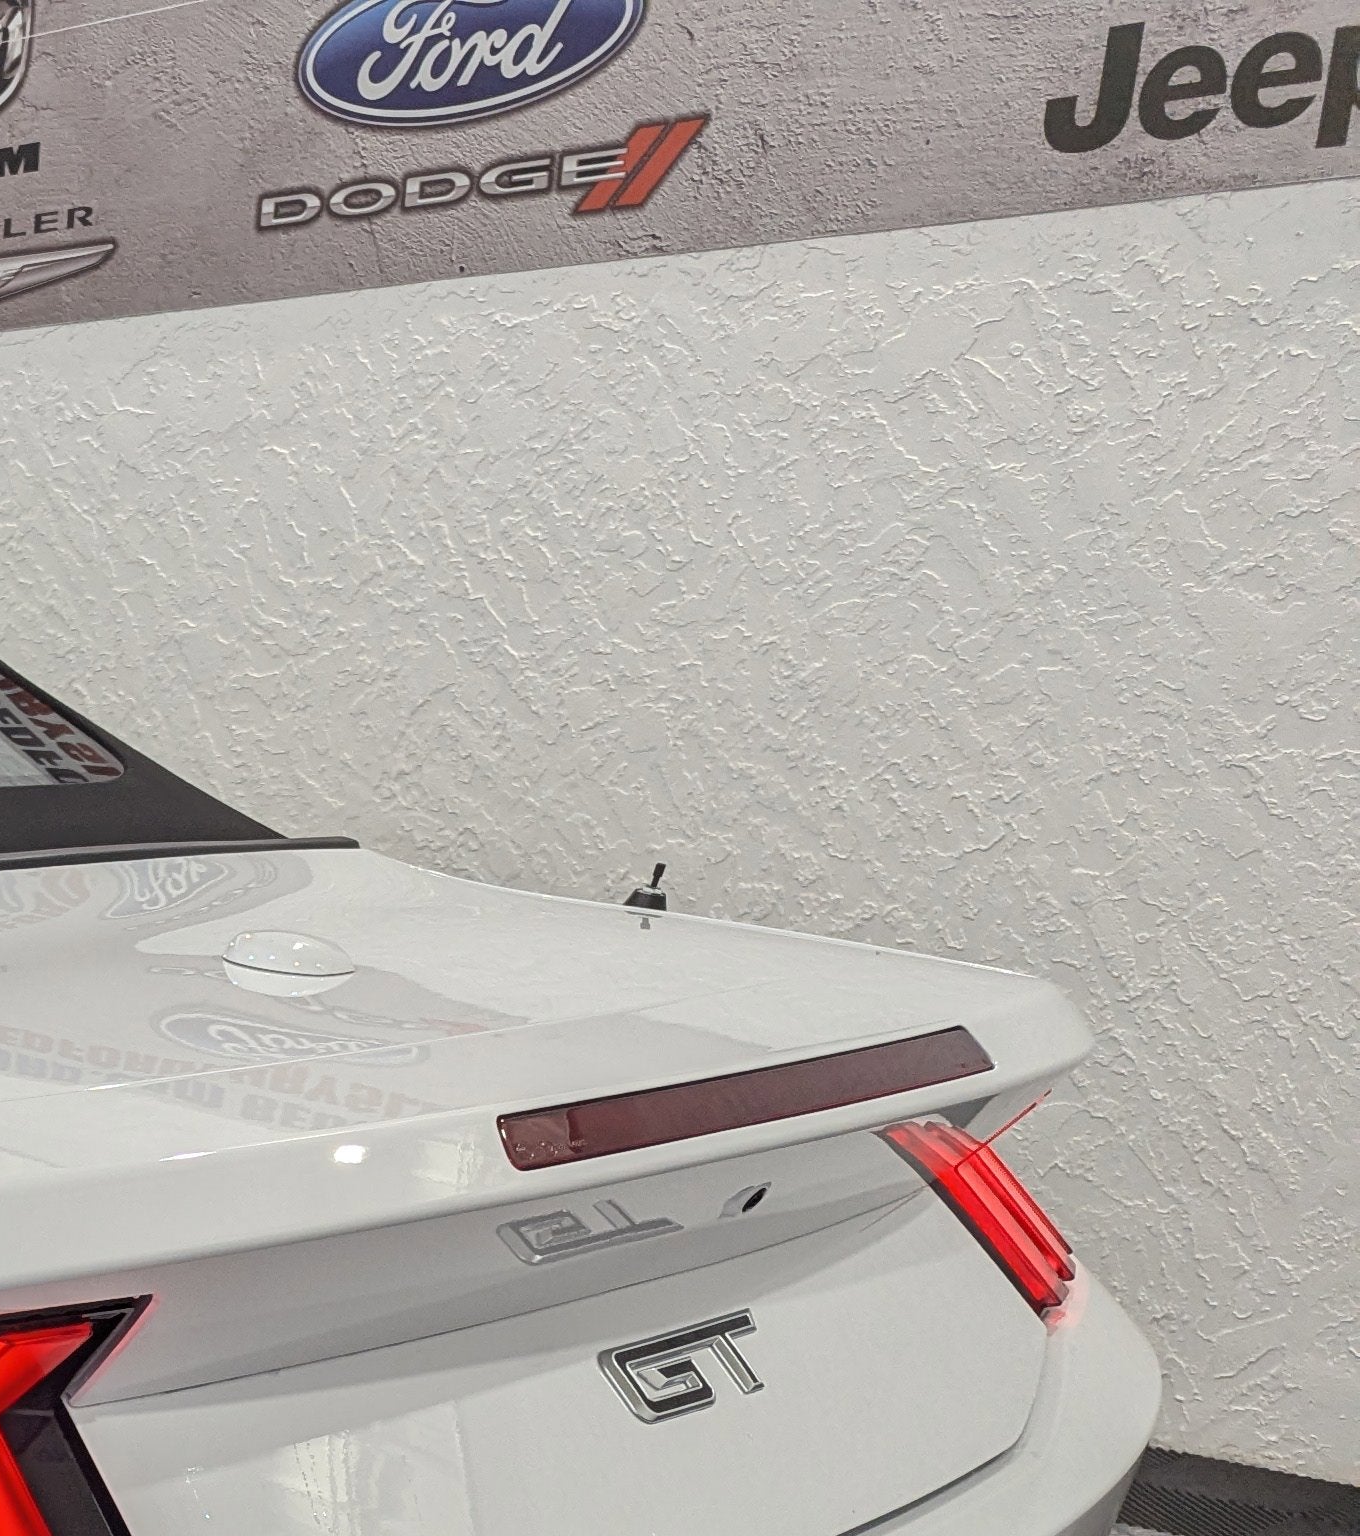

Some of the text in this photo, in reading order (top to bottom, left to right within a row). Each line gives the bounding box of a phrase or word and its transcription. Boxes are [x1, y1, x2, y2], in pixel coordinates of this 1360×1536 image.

[357, 0, 566, 100] Ford
[260, 148, 628, 227] DODGE
[596, 1307, 765, 1424] GT
